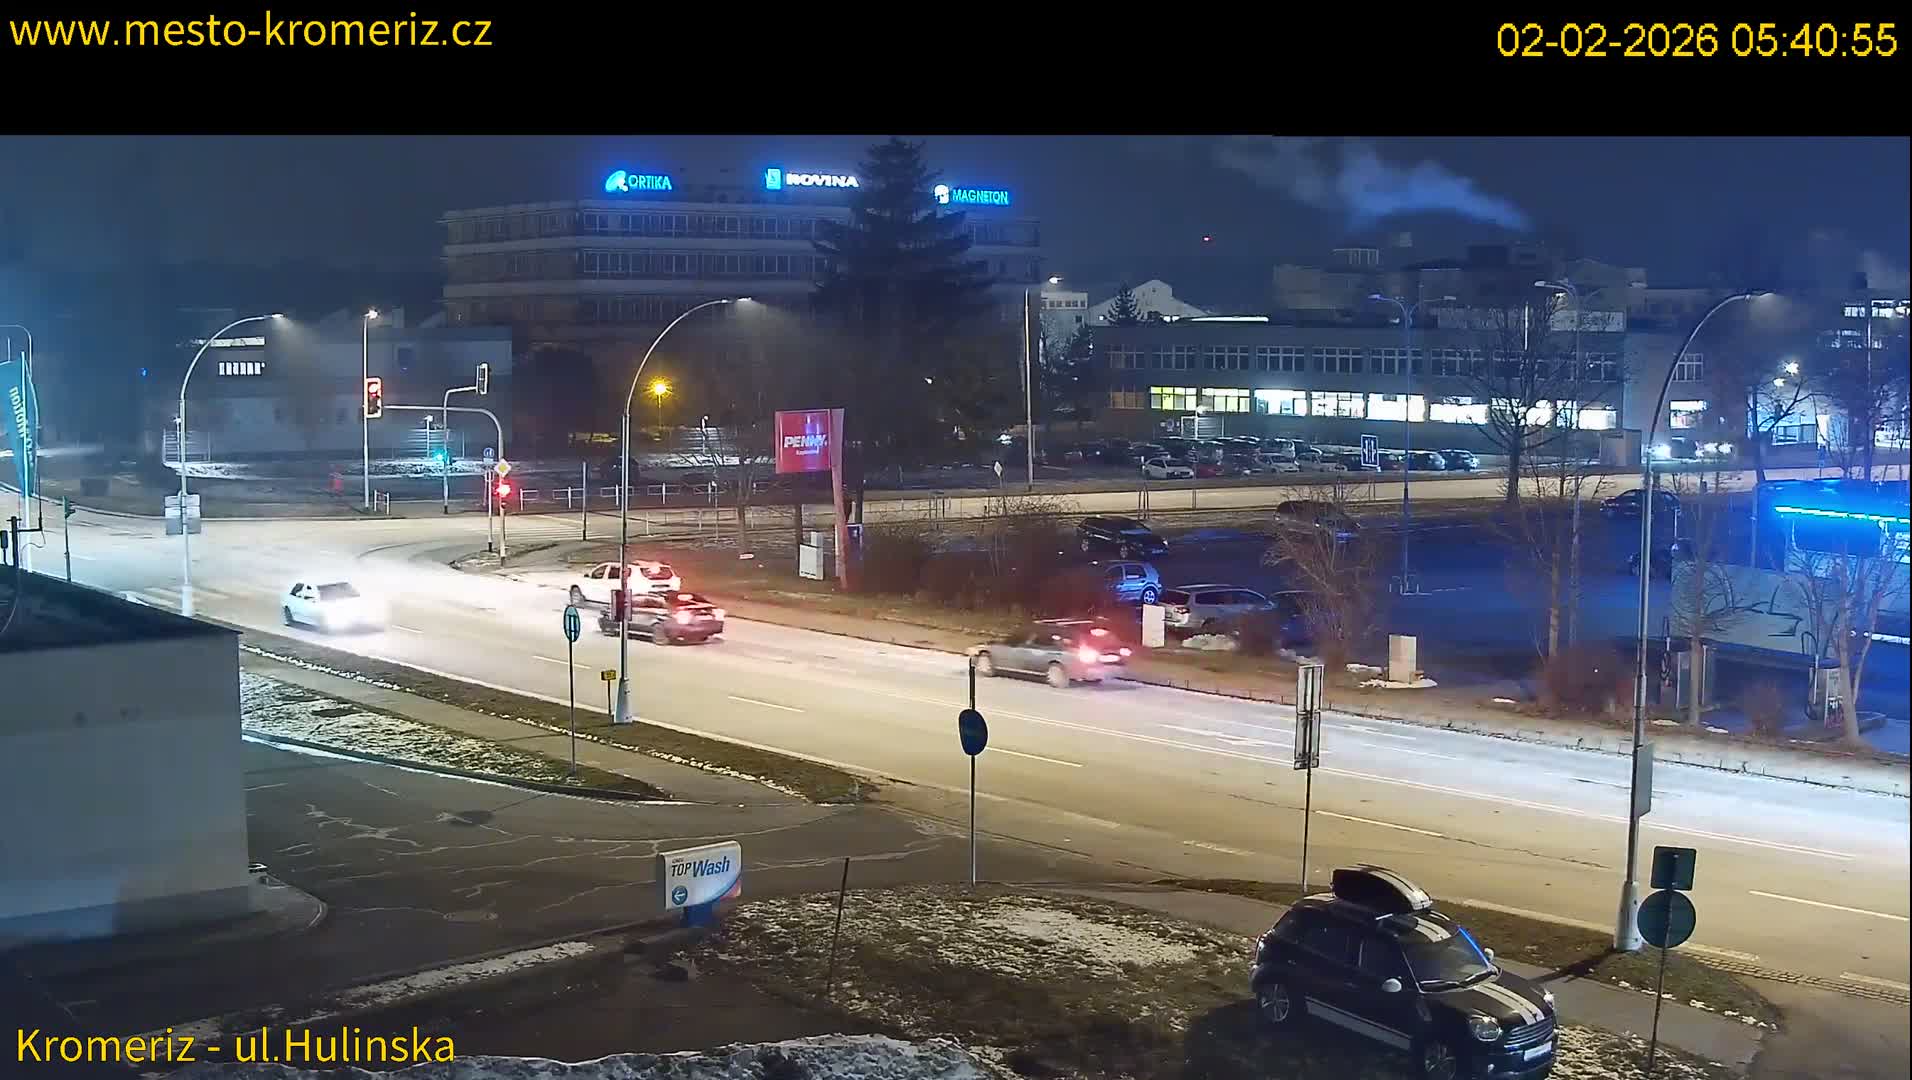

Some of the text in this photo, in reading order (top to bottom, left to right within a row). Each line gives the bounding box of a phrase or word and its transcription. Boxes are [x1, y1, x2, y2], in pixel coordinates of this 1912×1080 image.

[628, 175, 672, 190] ORTIKA
[786, 173, 859, 188] ROVINA
[952, 189, 1009, 205] MAGNETON
